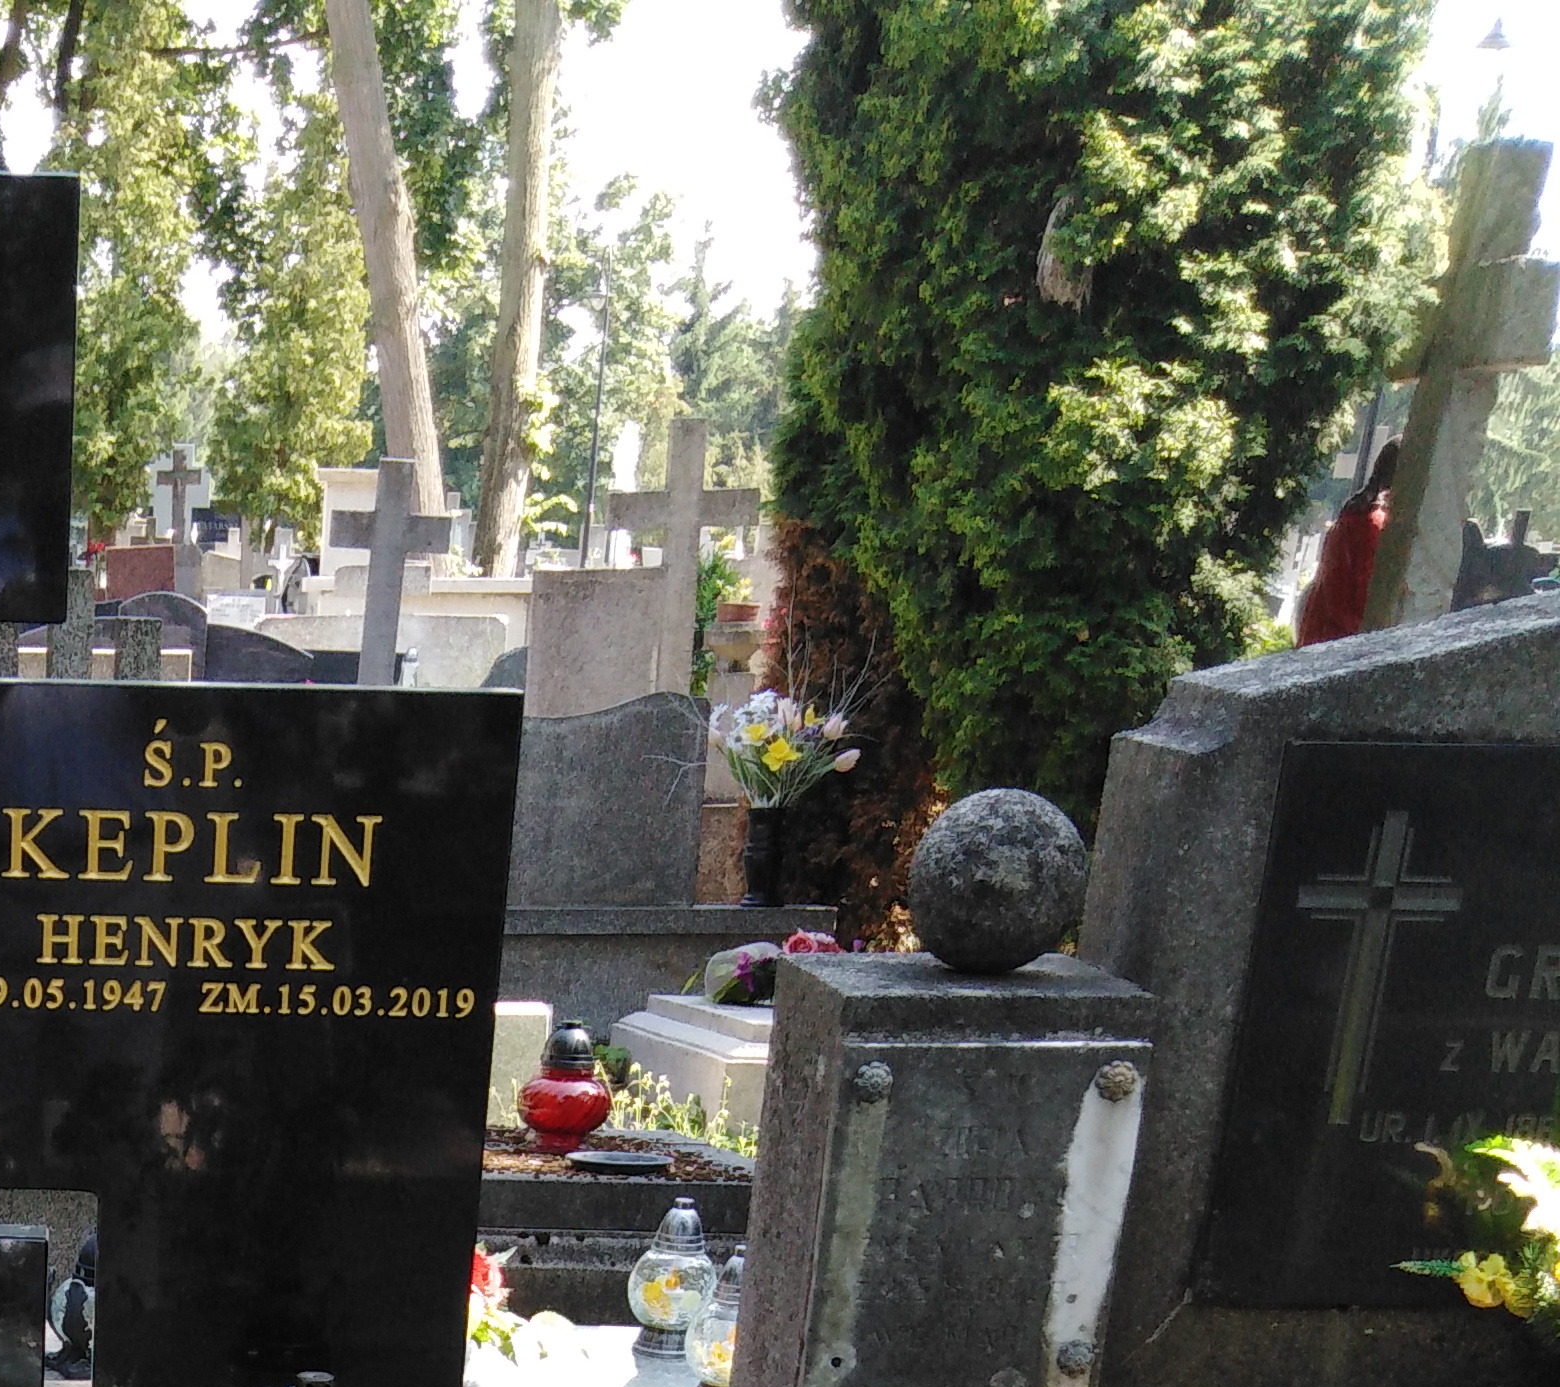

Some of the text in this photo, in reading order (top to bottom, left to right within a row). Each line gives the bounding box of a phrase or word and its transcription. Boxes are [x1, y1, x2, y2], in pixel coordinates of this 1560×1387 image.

[143, 719, 243, 788] Ś.P.
[1, 807, 383, 888] KEPLIN
[36, 913, 336, 971] HENRYK
[198, 982, 476, 1018] ZM.15.03.2019
